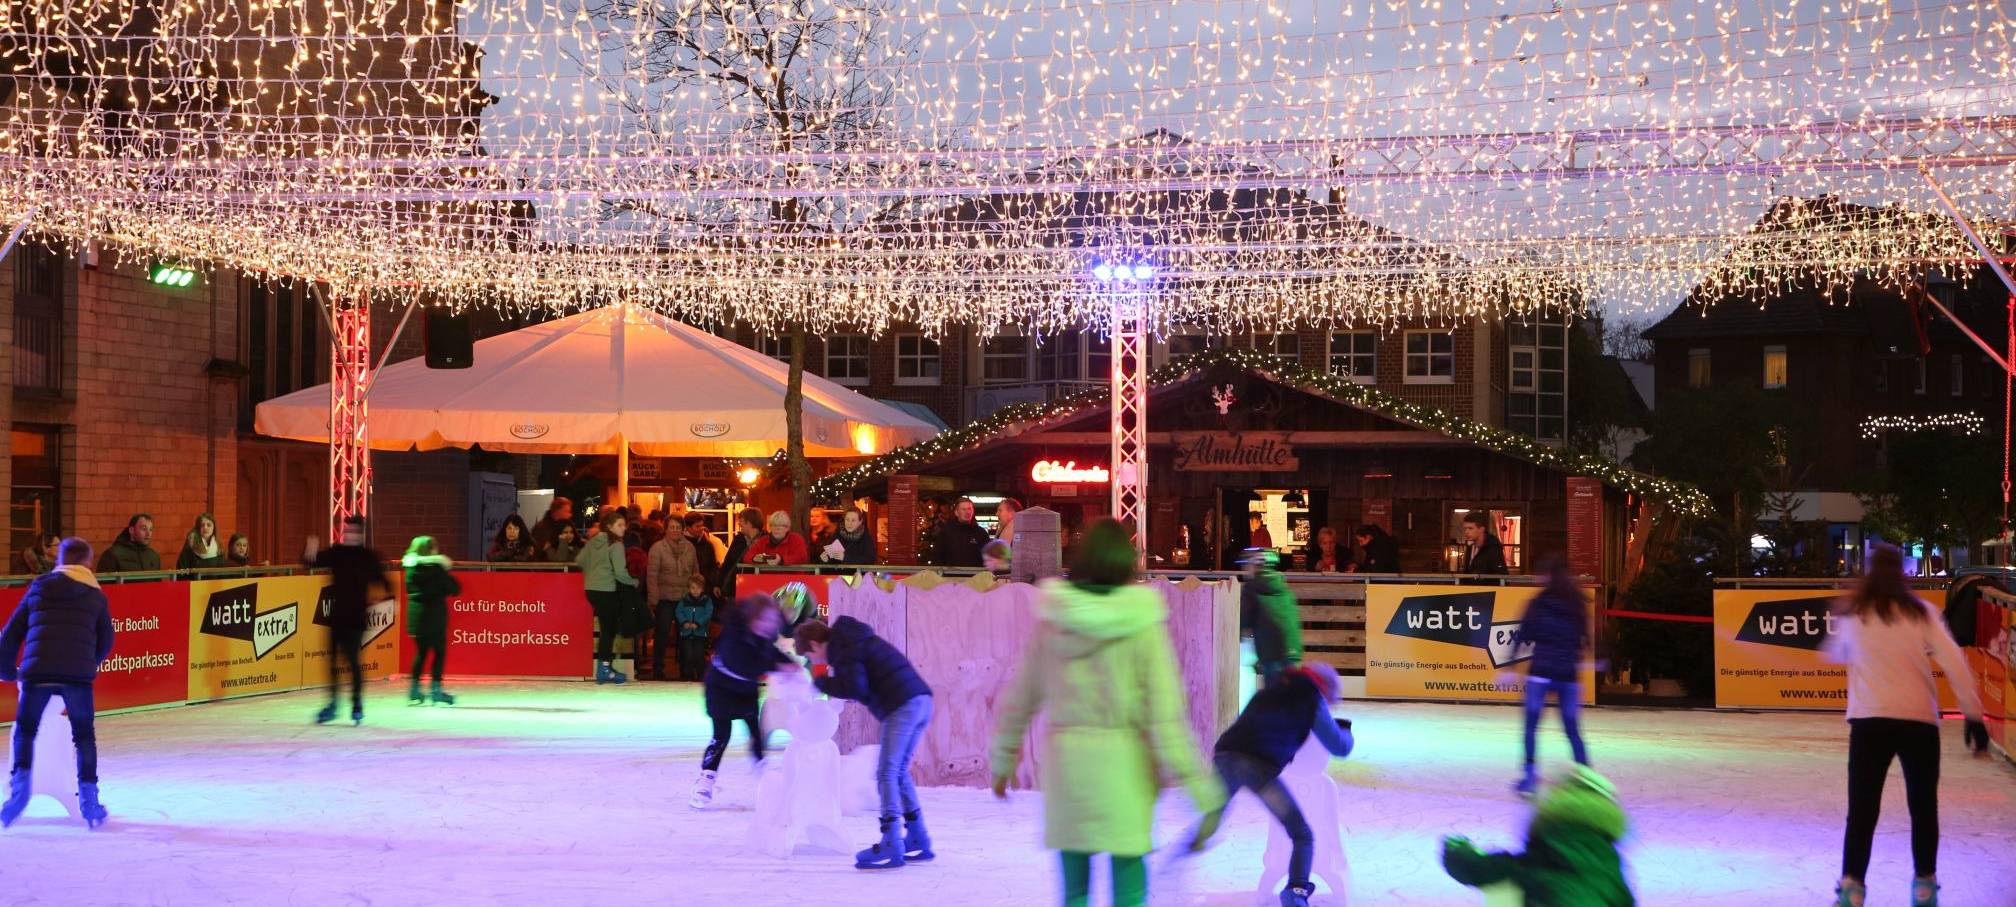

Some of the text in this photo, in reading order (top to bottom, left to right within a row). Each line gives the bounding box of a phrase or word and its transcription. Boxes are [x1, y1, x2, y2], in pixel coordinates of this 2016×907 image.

[1177, 434, 1287, 468] Almhütte
[211, 598, 252, 626] watt
[453, 599, 546, 613] Gut für Bocholt
[816, 603, 829, 617] fü
[125, 615, 160, 632] Bocholt
[1406, 605, 1482, 630] watt
[1759, 610, 1842, 635] watt
[453, 628, 570, 648] Stadtsparkasse
[96, 650, 175, 674] tadtsparkasse
[1384, 661, 1414, 670] günstige
[1416, 662, 1443, 671] Energie
[221, 671, 277, 689] www.wattextra.de
[1720, 668, 1733, 676] Die
[1735, 668, 1768, 678] günstige
[1770, 669, 1800, 678] Energie
